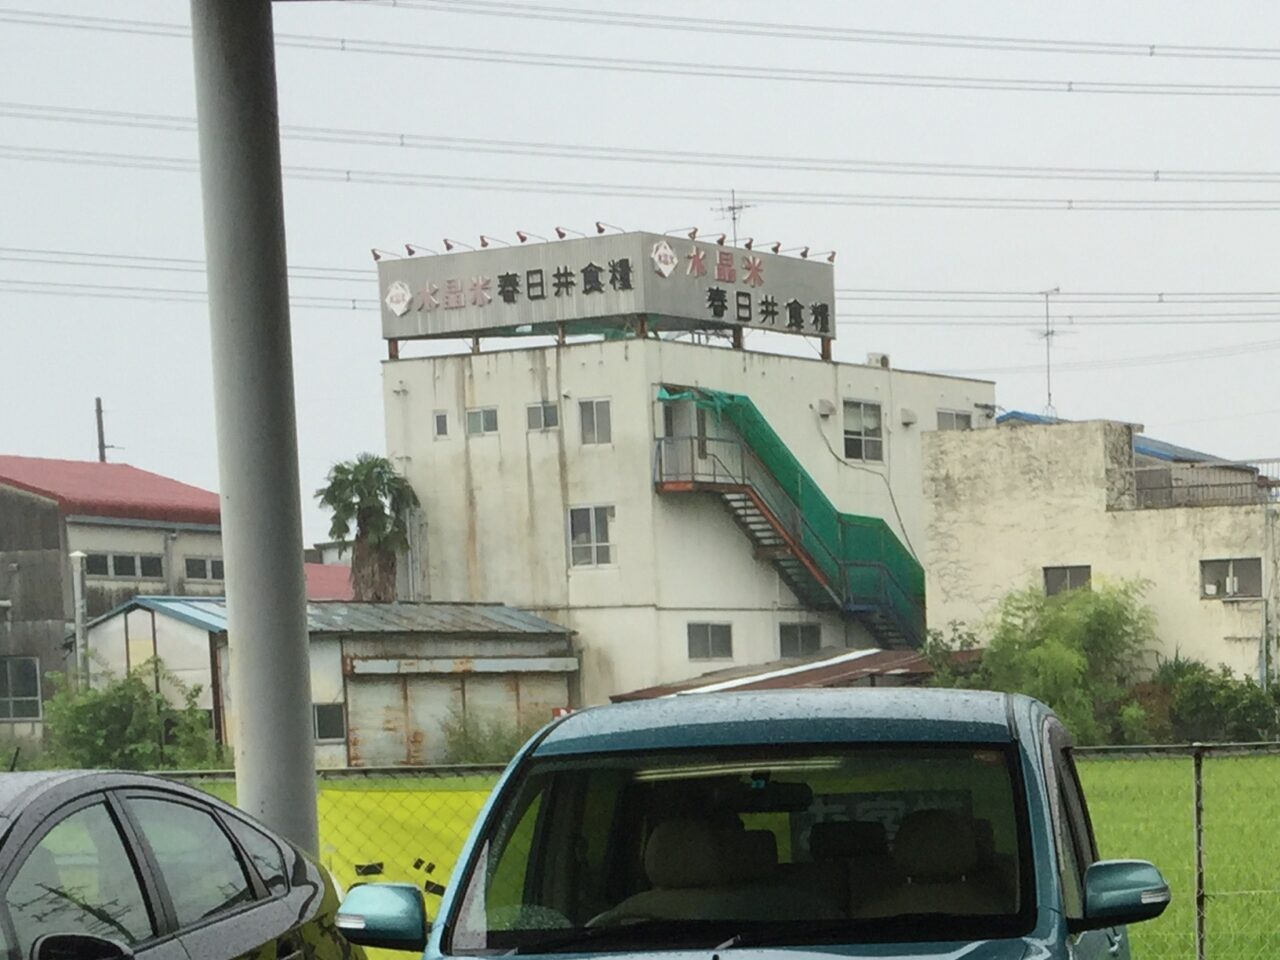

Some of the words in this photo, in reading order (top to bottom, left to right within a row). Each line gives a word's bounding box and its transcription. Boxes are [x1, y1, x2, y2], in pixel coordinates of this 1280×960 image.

[497, 258, 634, 304] 春日井食糧
[686, 245, 764, 288] 水晶米
[707, 286, 830, 333] 春日井食糧
